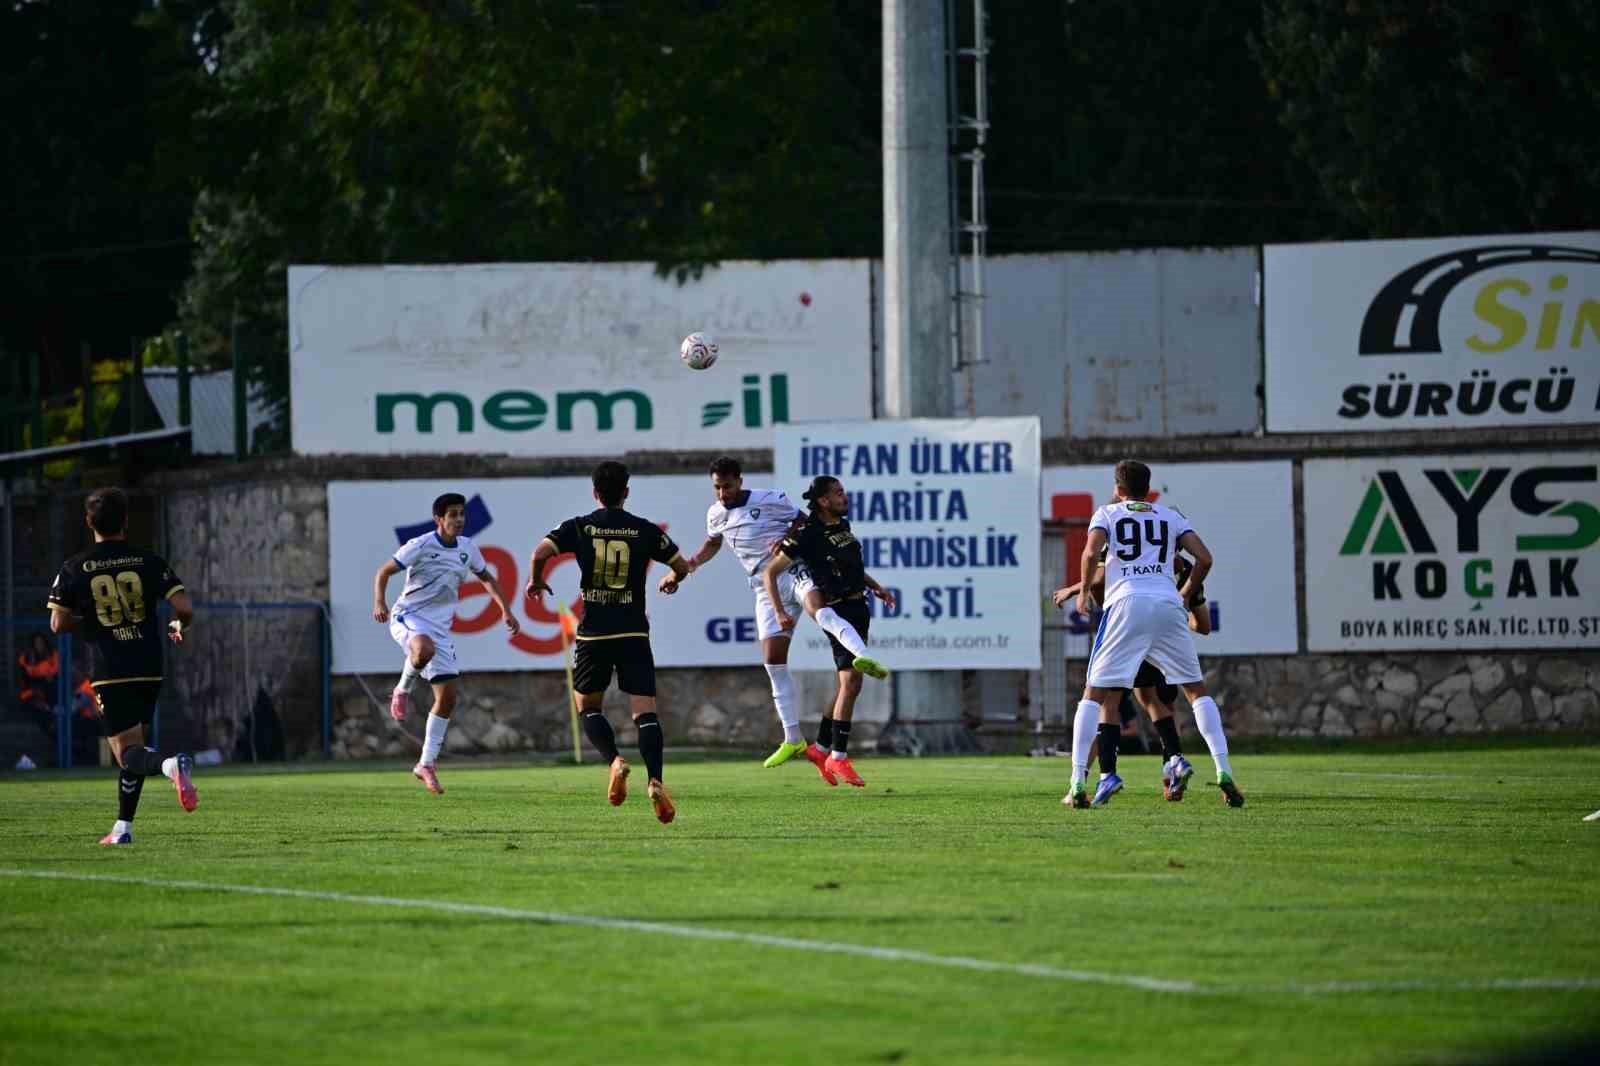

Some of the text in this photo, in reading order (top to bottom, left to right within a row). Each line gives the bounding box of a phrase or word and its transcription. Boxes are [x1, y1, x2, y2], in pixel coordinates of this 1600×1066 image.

[375, 389, 654, 433] mem
[1339, 367, 1575, 418] SÜRÜCÜ
[800, 437, 1013, 476] İRFAN ÜLKER
[847, 482, 967, 522] HARİTA
[1339, 465, 1600, 555] AYS
[593, 537, 630, 588] 10
[862, 527, 1020, 568] ENDİSLİK
[1116, 517, 1168, 563] 94
[1121, 564, 1163, 577] T. KAYA
[1372, 558, 1580, 611] KOÇAK
[922, 577, 983, 624] ŞTİ.
[1341, 619, 1387, 638] BOYA
[1393, 618, 1448, 639] KİREÇ
